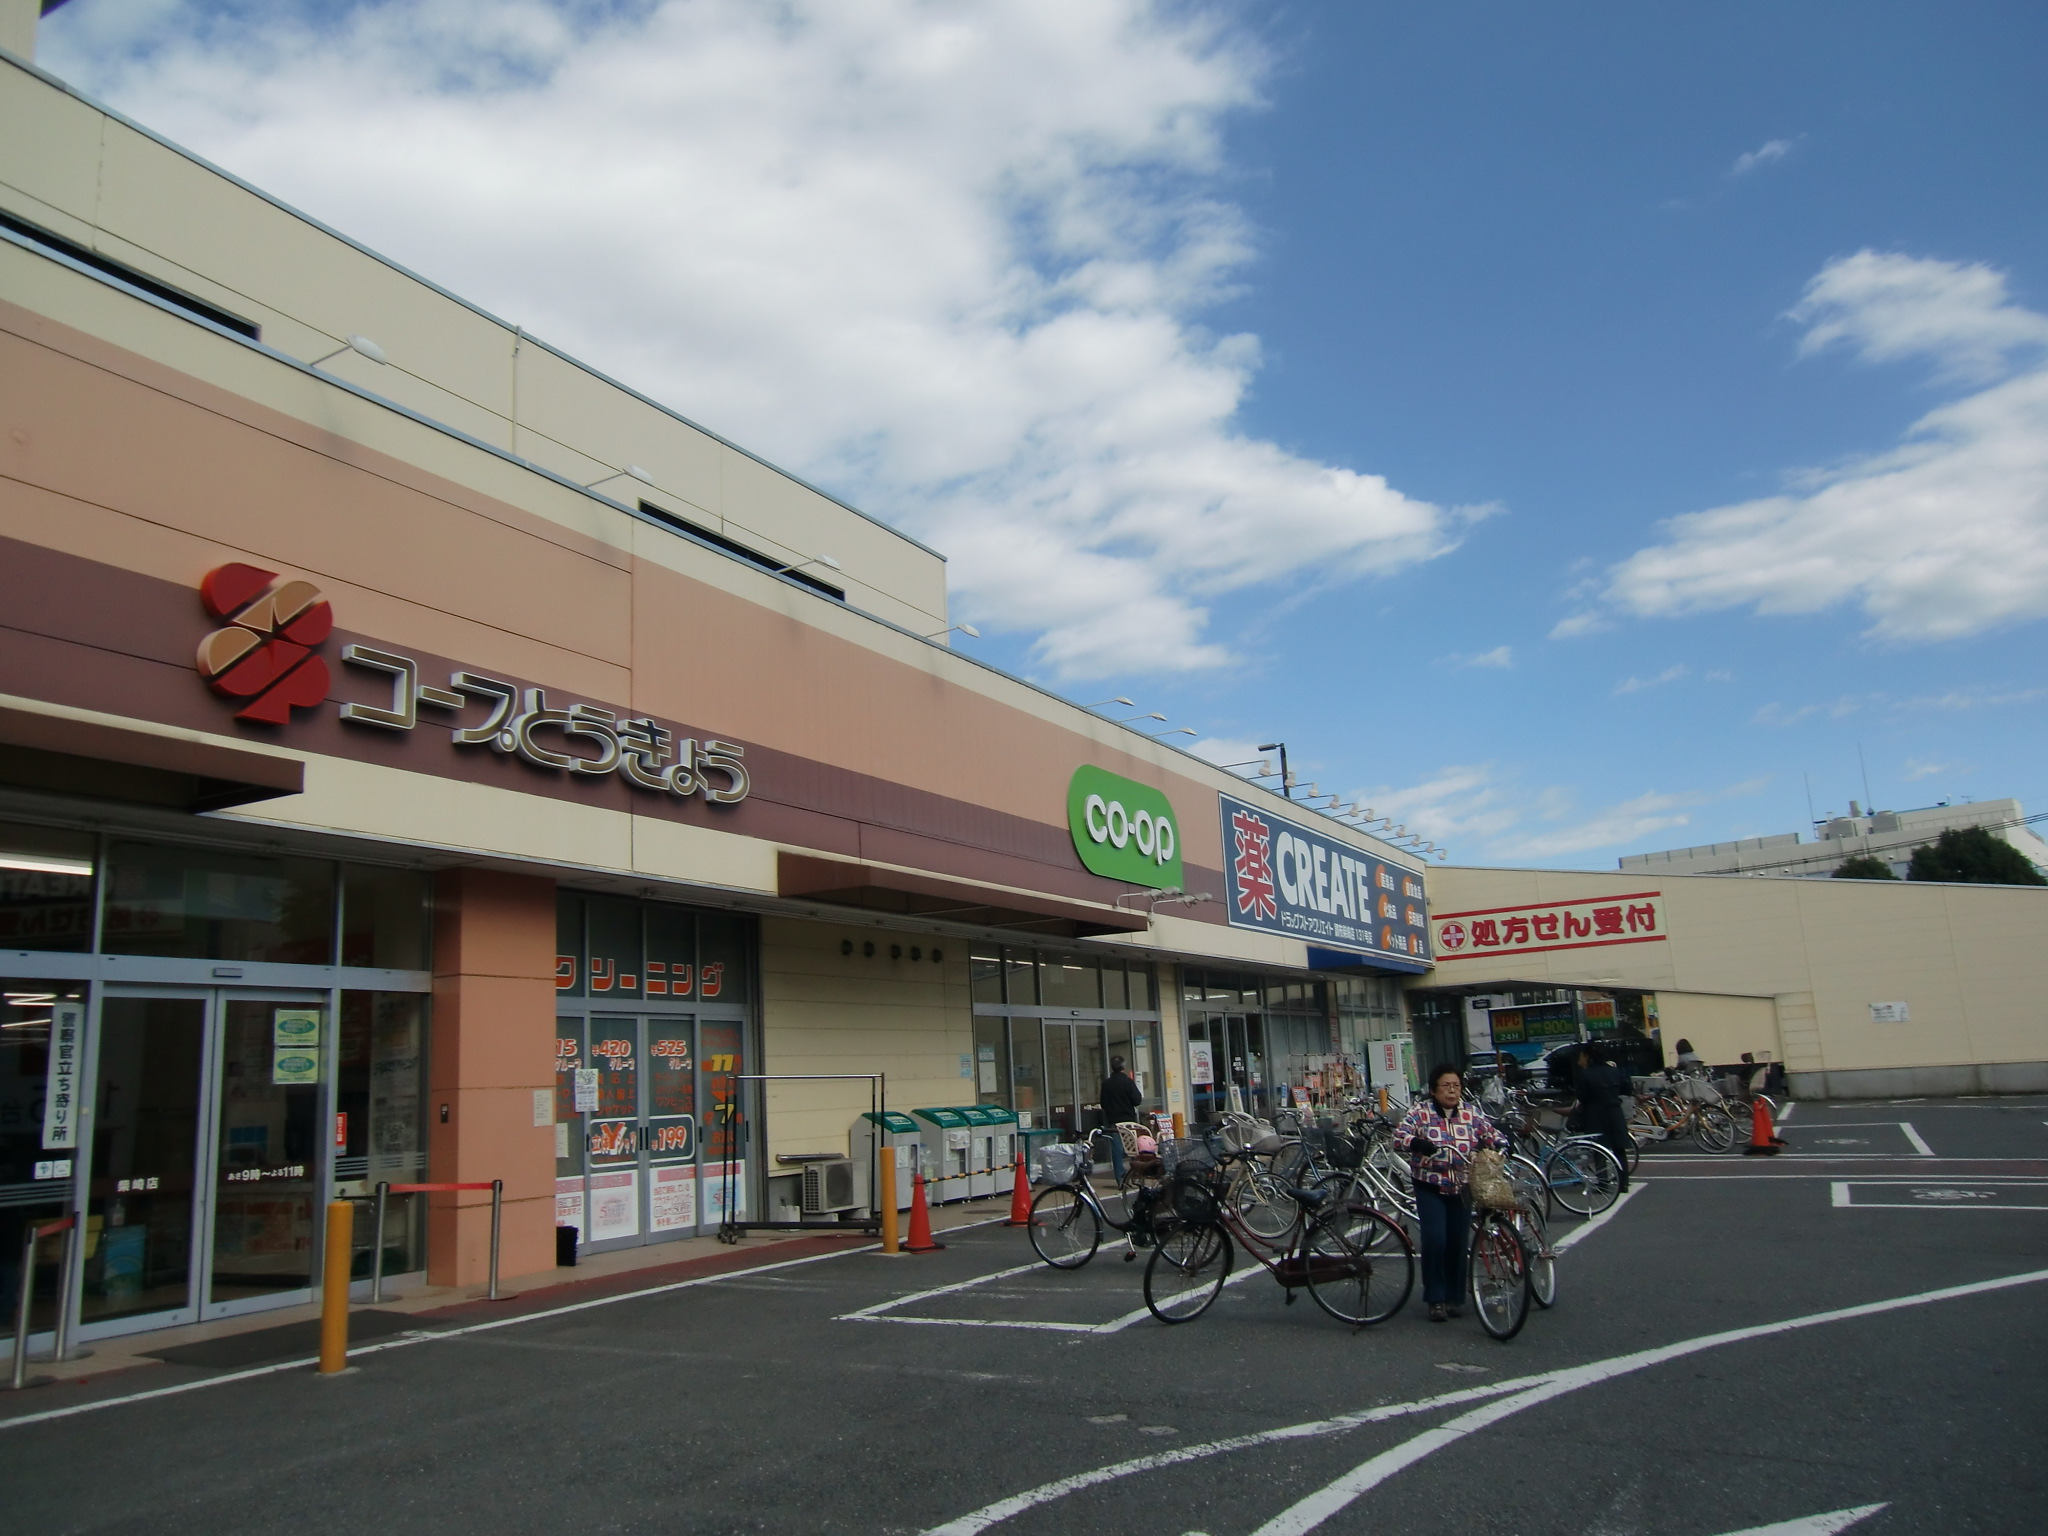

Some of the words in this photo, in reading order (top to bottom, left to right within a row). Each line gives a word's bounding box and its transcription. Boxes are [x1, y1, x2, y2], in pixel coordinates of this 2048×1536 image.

[340, 643, 750, 804] コープとうきょう
[1232, 809, 1277, 921] 薬
[1276, 831, 1372, 924] CREATE
[1471, 902, 1656, 948] 処方せん受付
[1495, 1015, 1520, 1028] NPC
[1586, 1002, 1612, 1017] NPC
[592, 1040, 631, 1057] ¥420
[650, 1040, 688, 1057] ¥525
[1499, 1032, 1520, 1041] 24H
[52, 1012, 76, 1142] 警察官立ち寄り所
[651, 1125, 687, 1151] ¥199
